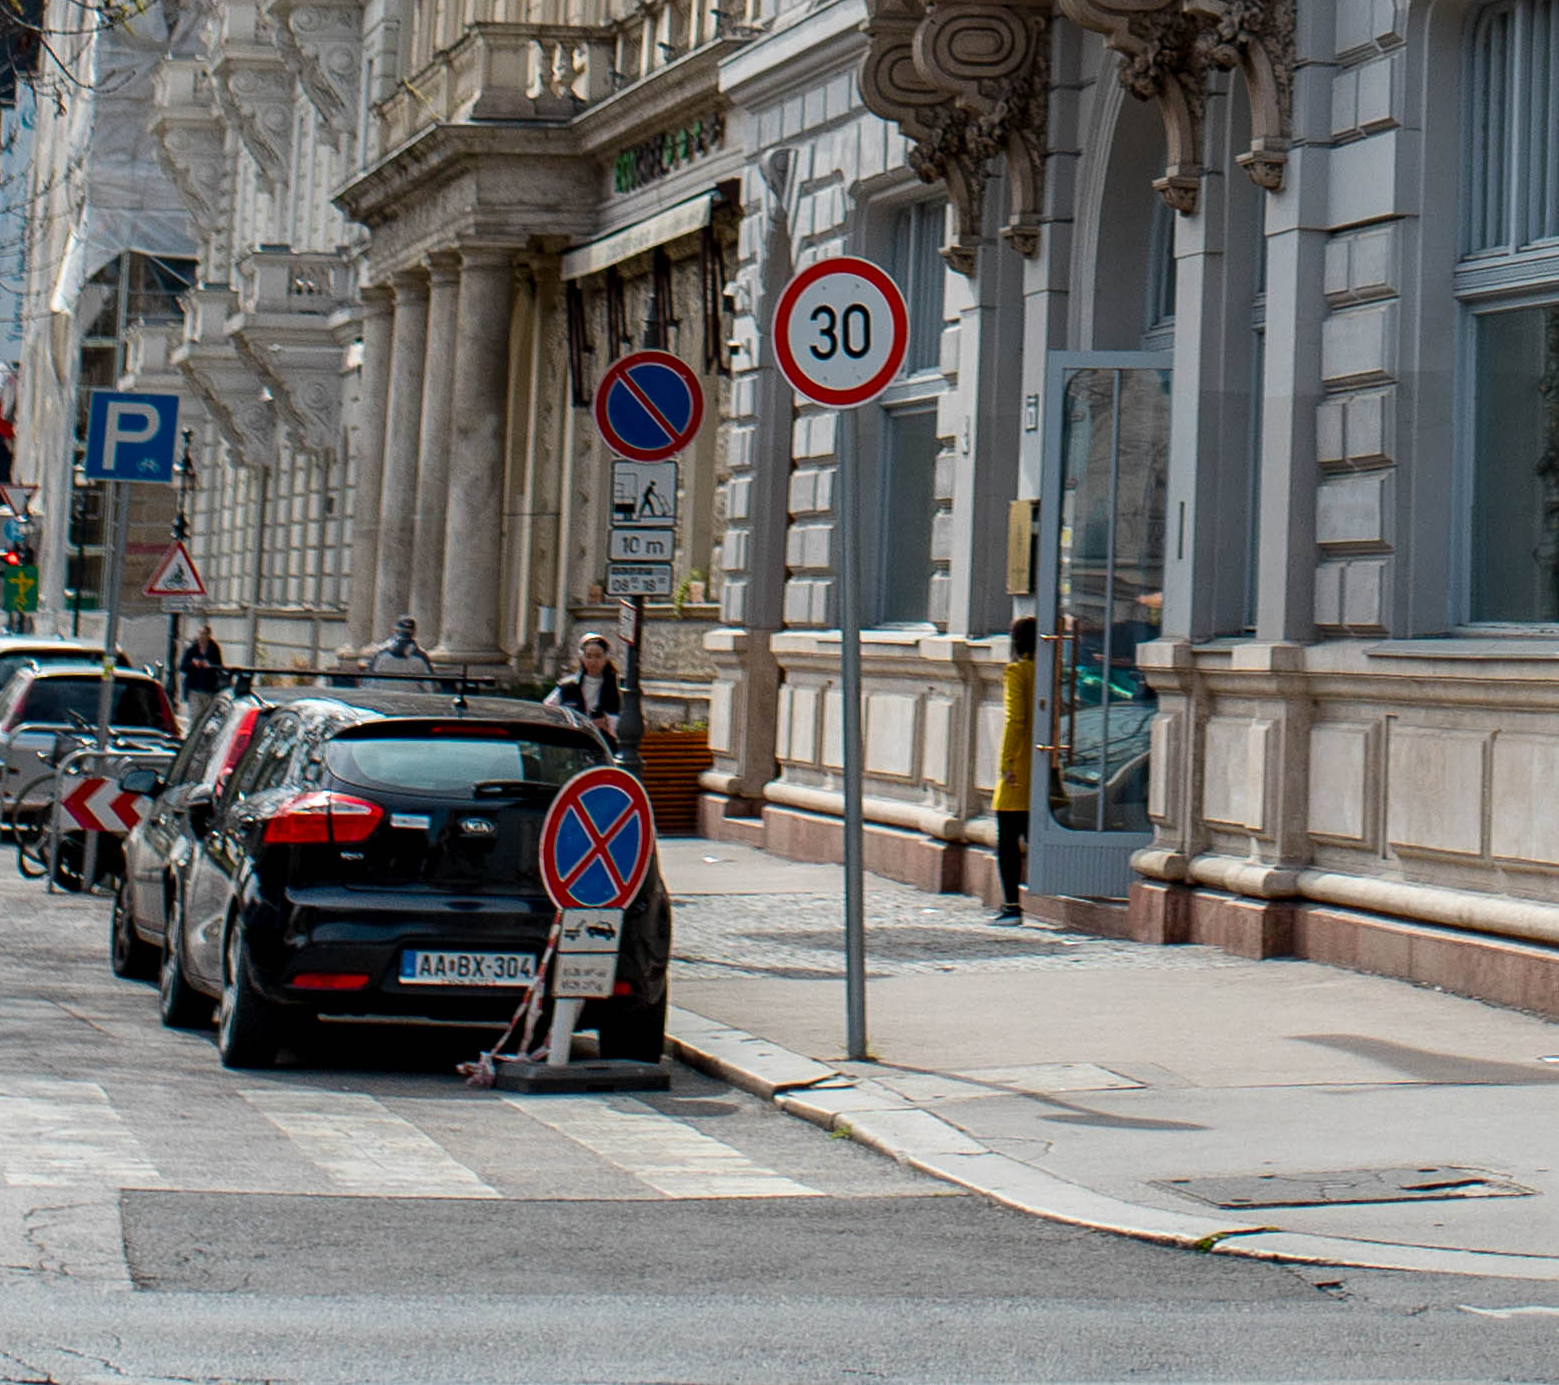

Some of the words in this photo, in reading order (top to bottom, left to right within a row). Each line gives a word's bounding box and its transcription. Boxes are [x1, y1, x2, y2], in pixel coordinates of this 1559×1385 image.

[809, 303, 871, 361] 30
[102, 401, 161, 470] P
[623, 535, 640, 554] 10
[646, 540, 664, 554] m
